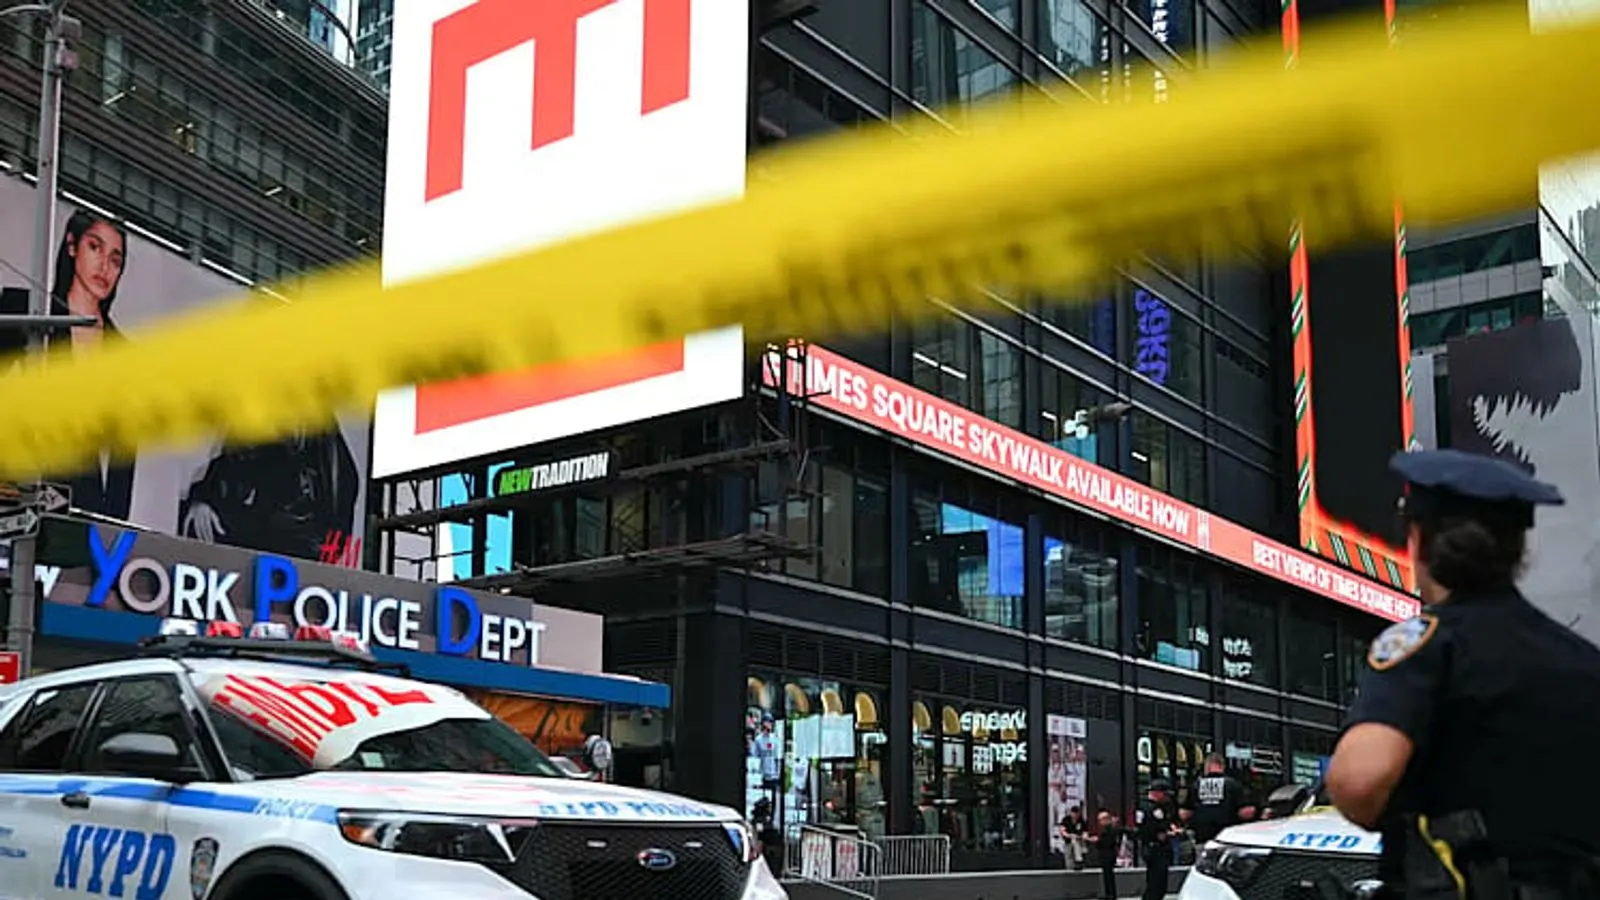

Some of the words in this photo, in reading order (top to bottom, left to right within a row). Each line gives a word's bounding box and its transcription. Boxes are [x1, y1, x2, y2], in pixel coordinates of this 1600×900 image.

[873, 384, 965, 449] SQUARE
[969, 423, 1064, 488] SKYWALK
[1066, 463, 1150, 521] AVAILABLE
[1152, 499, 1190, 536] NOW
[85, 521, 241, 623] YORK
[253, 554, 421, 650] POLICE
[436, 585, 546, 667] DEPT
[1253, 540, 1282, 572] BEST
[1282, 551, 1317, 586] VIEWS
[1317, 565, 1333, 590] OF
[1332, 571, 1360, 601] TIMES
[1360, 581, 1394, 617] SQUARE
[54, 824, 176, 900] NYPD
[1279, 832, 1361, 849] NYPD
